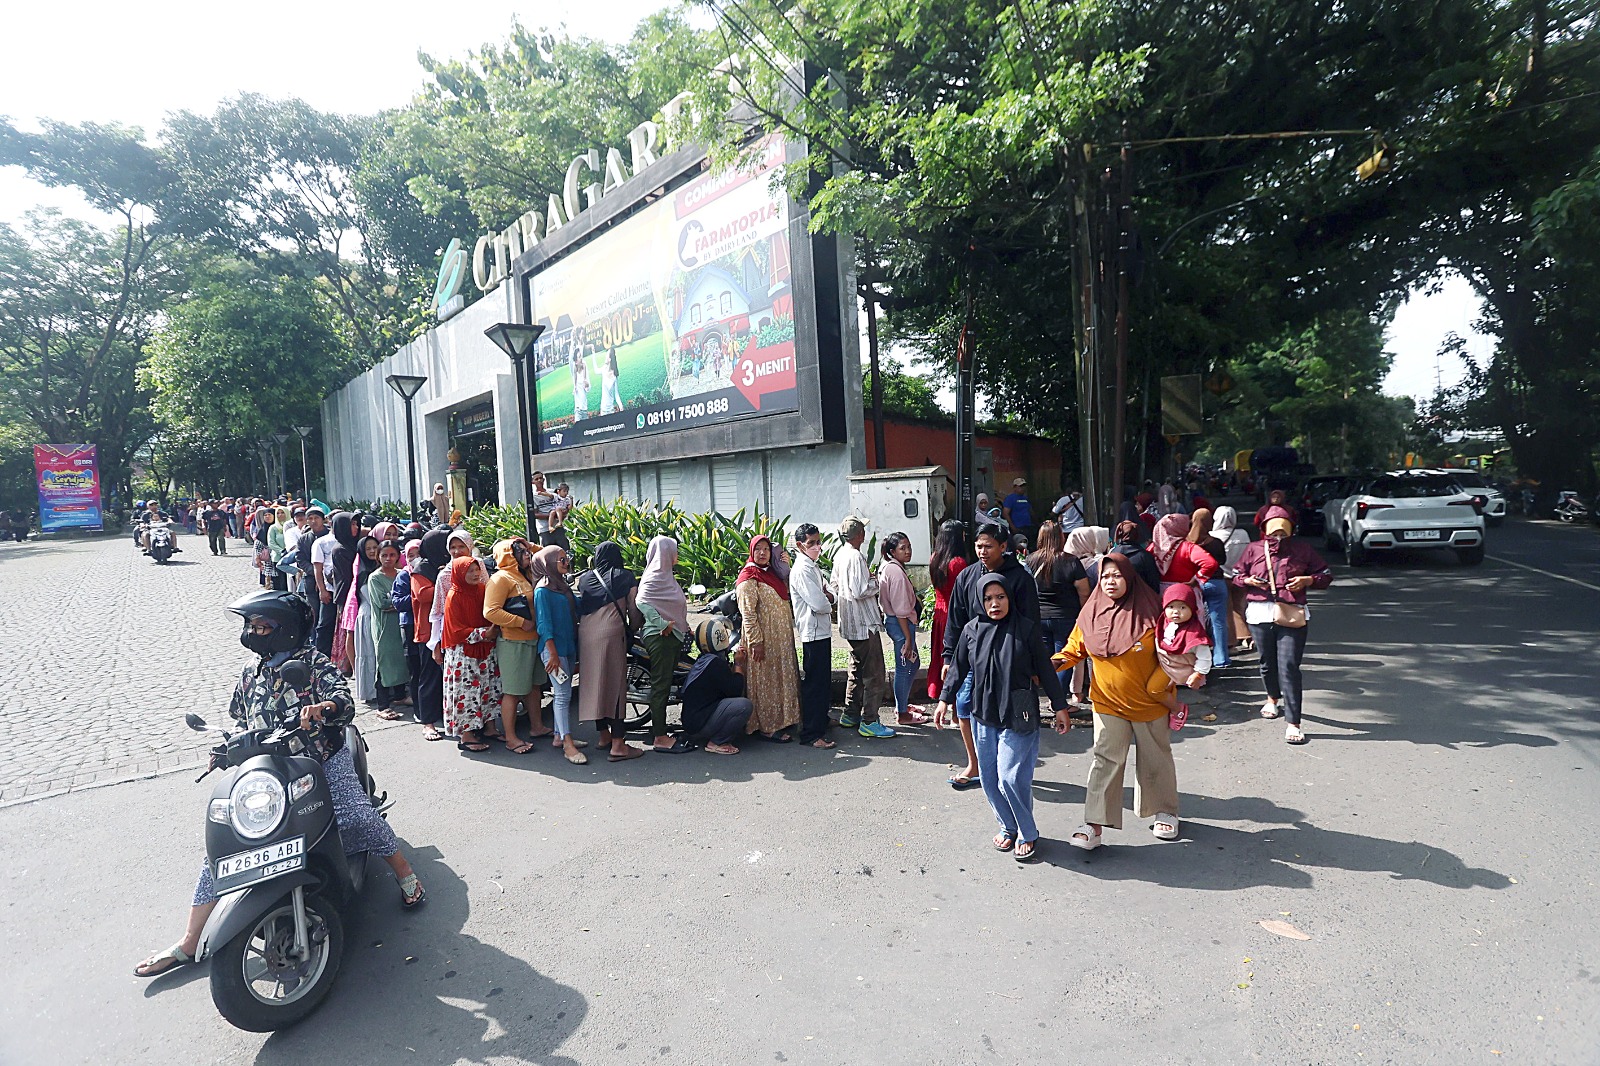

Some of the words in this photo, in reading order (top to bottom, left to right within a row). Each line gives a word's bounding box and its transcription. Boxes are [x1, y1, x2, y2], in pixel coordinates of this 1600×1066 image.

[473, 45, 772, 292] CITRAGAR
[684, 166, 736, 208] COMING
[737, 139, 782, 179] SON
[695, 202, 777, 254] FARMTOPIA
[703, 251, 711, 261] BY
[715, 230, 757, 257] DAIRYLAND
[608, 287, 628, 306] Called
[628, 281, 650, 298] Home
[602, 307, 633, 350] 800
[741, 359, 755, 386] 3
[755, 356, 791, 378] MENIT
[647, 407, 676, 426] 08191
[678, 402, 705, 420] 7500
[706, 397, 729, 415] 888
[222, 862, 230, 875] N
[235, 850, 270, 871] 2636
[277, 841, 300, 858] ABI
